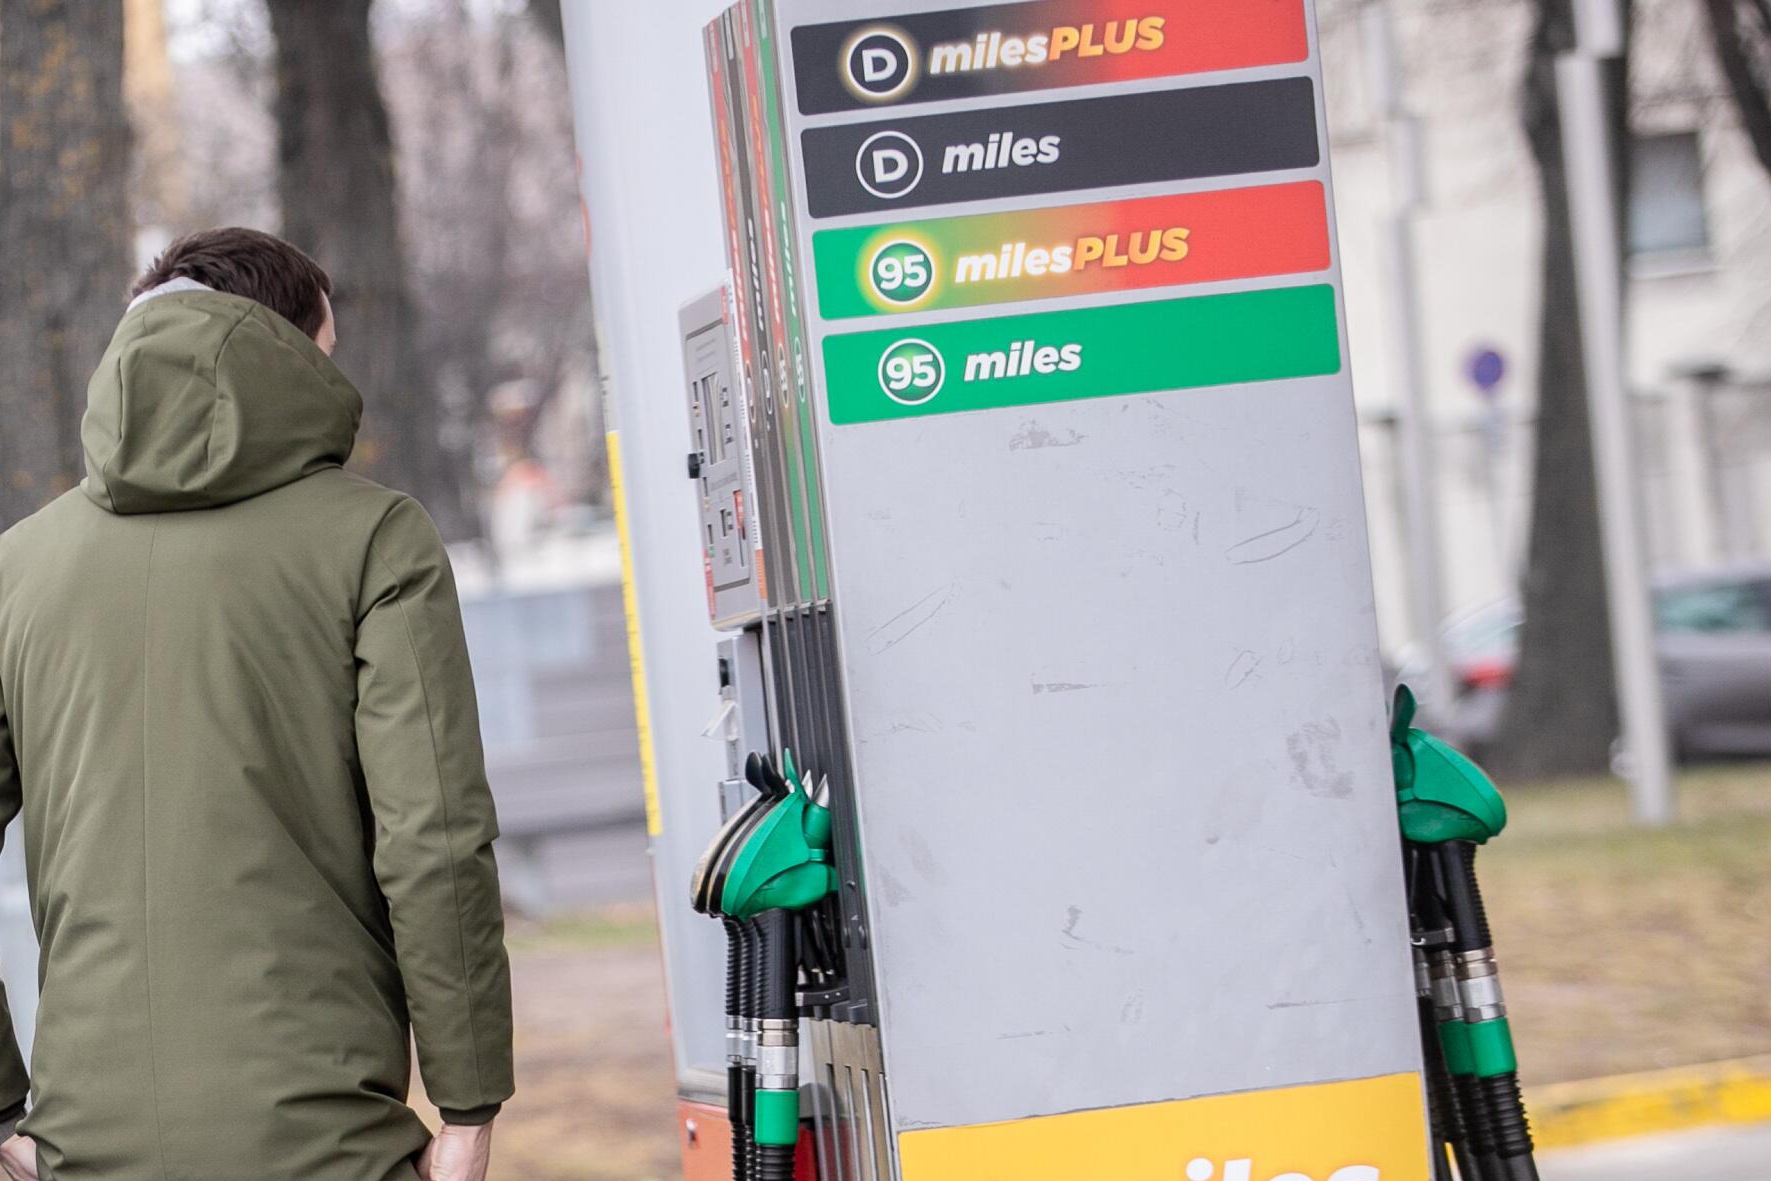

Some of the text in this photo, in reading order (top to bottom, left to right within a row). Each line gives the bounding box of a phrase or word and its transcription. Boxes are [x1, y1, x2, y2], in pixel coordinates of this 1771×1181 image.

[862, 48, 898, 83] D
[872, 132, 1061, 183] D miles
[877, 254, 928, 288] 95
[885, 340, 1082, 389] 95 miles
